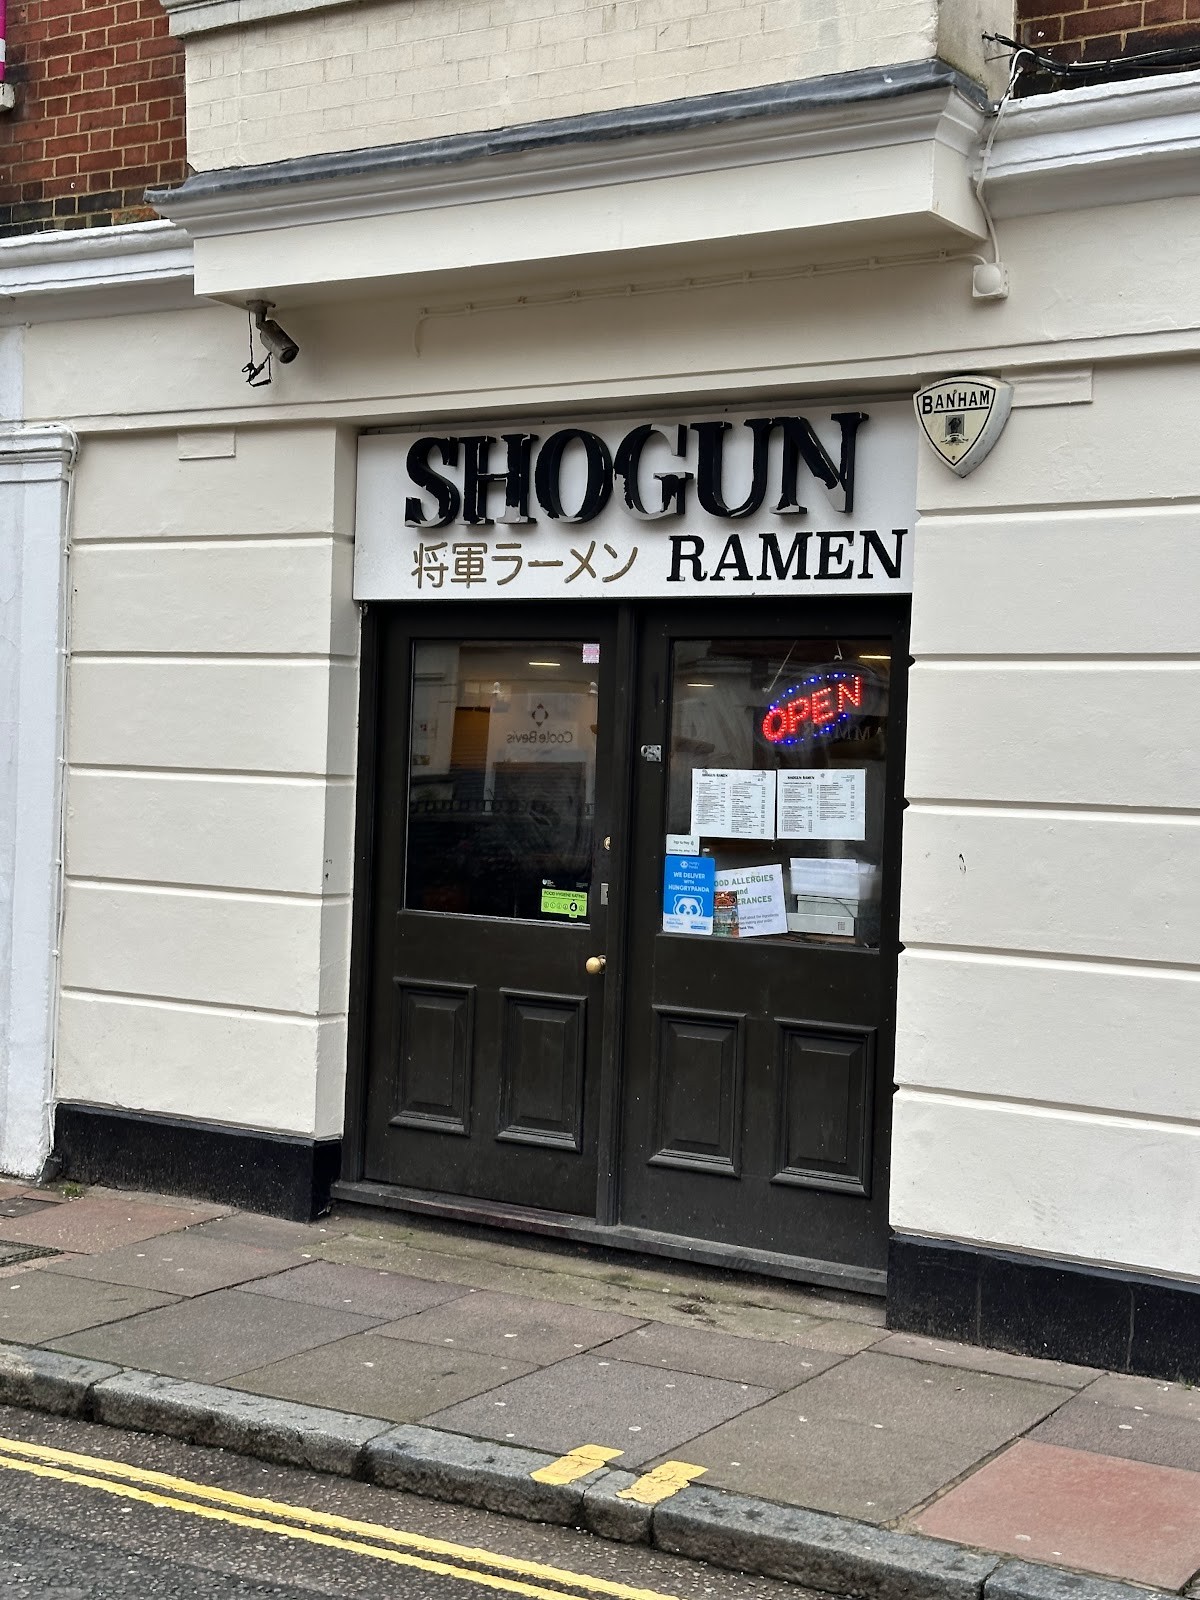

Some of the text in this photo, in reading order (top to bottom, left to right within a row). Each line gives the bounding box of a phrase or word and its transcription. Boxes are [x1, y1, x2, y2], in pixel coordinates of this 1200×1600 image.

[922, 390, 989, 414] BANHAM
[404, 412, 869, 527] SHOGUN
[411, 540, 639, 589] 将軍ラーメン
[666, 529, 909, 582] RAMEN
[762, 674, 862, 741] OPEN
[668, 884, 710, 893] HUNGRYPANDA
[732, 874, 774, 886] ALLERGIES
[737, 896, 772, 905] ERANCES
